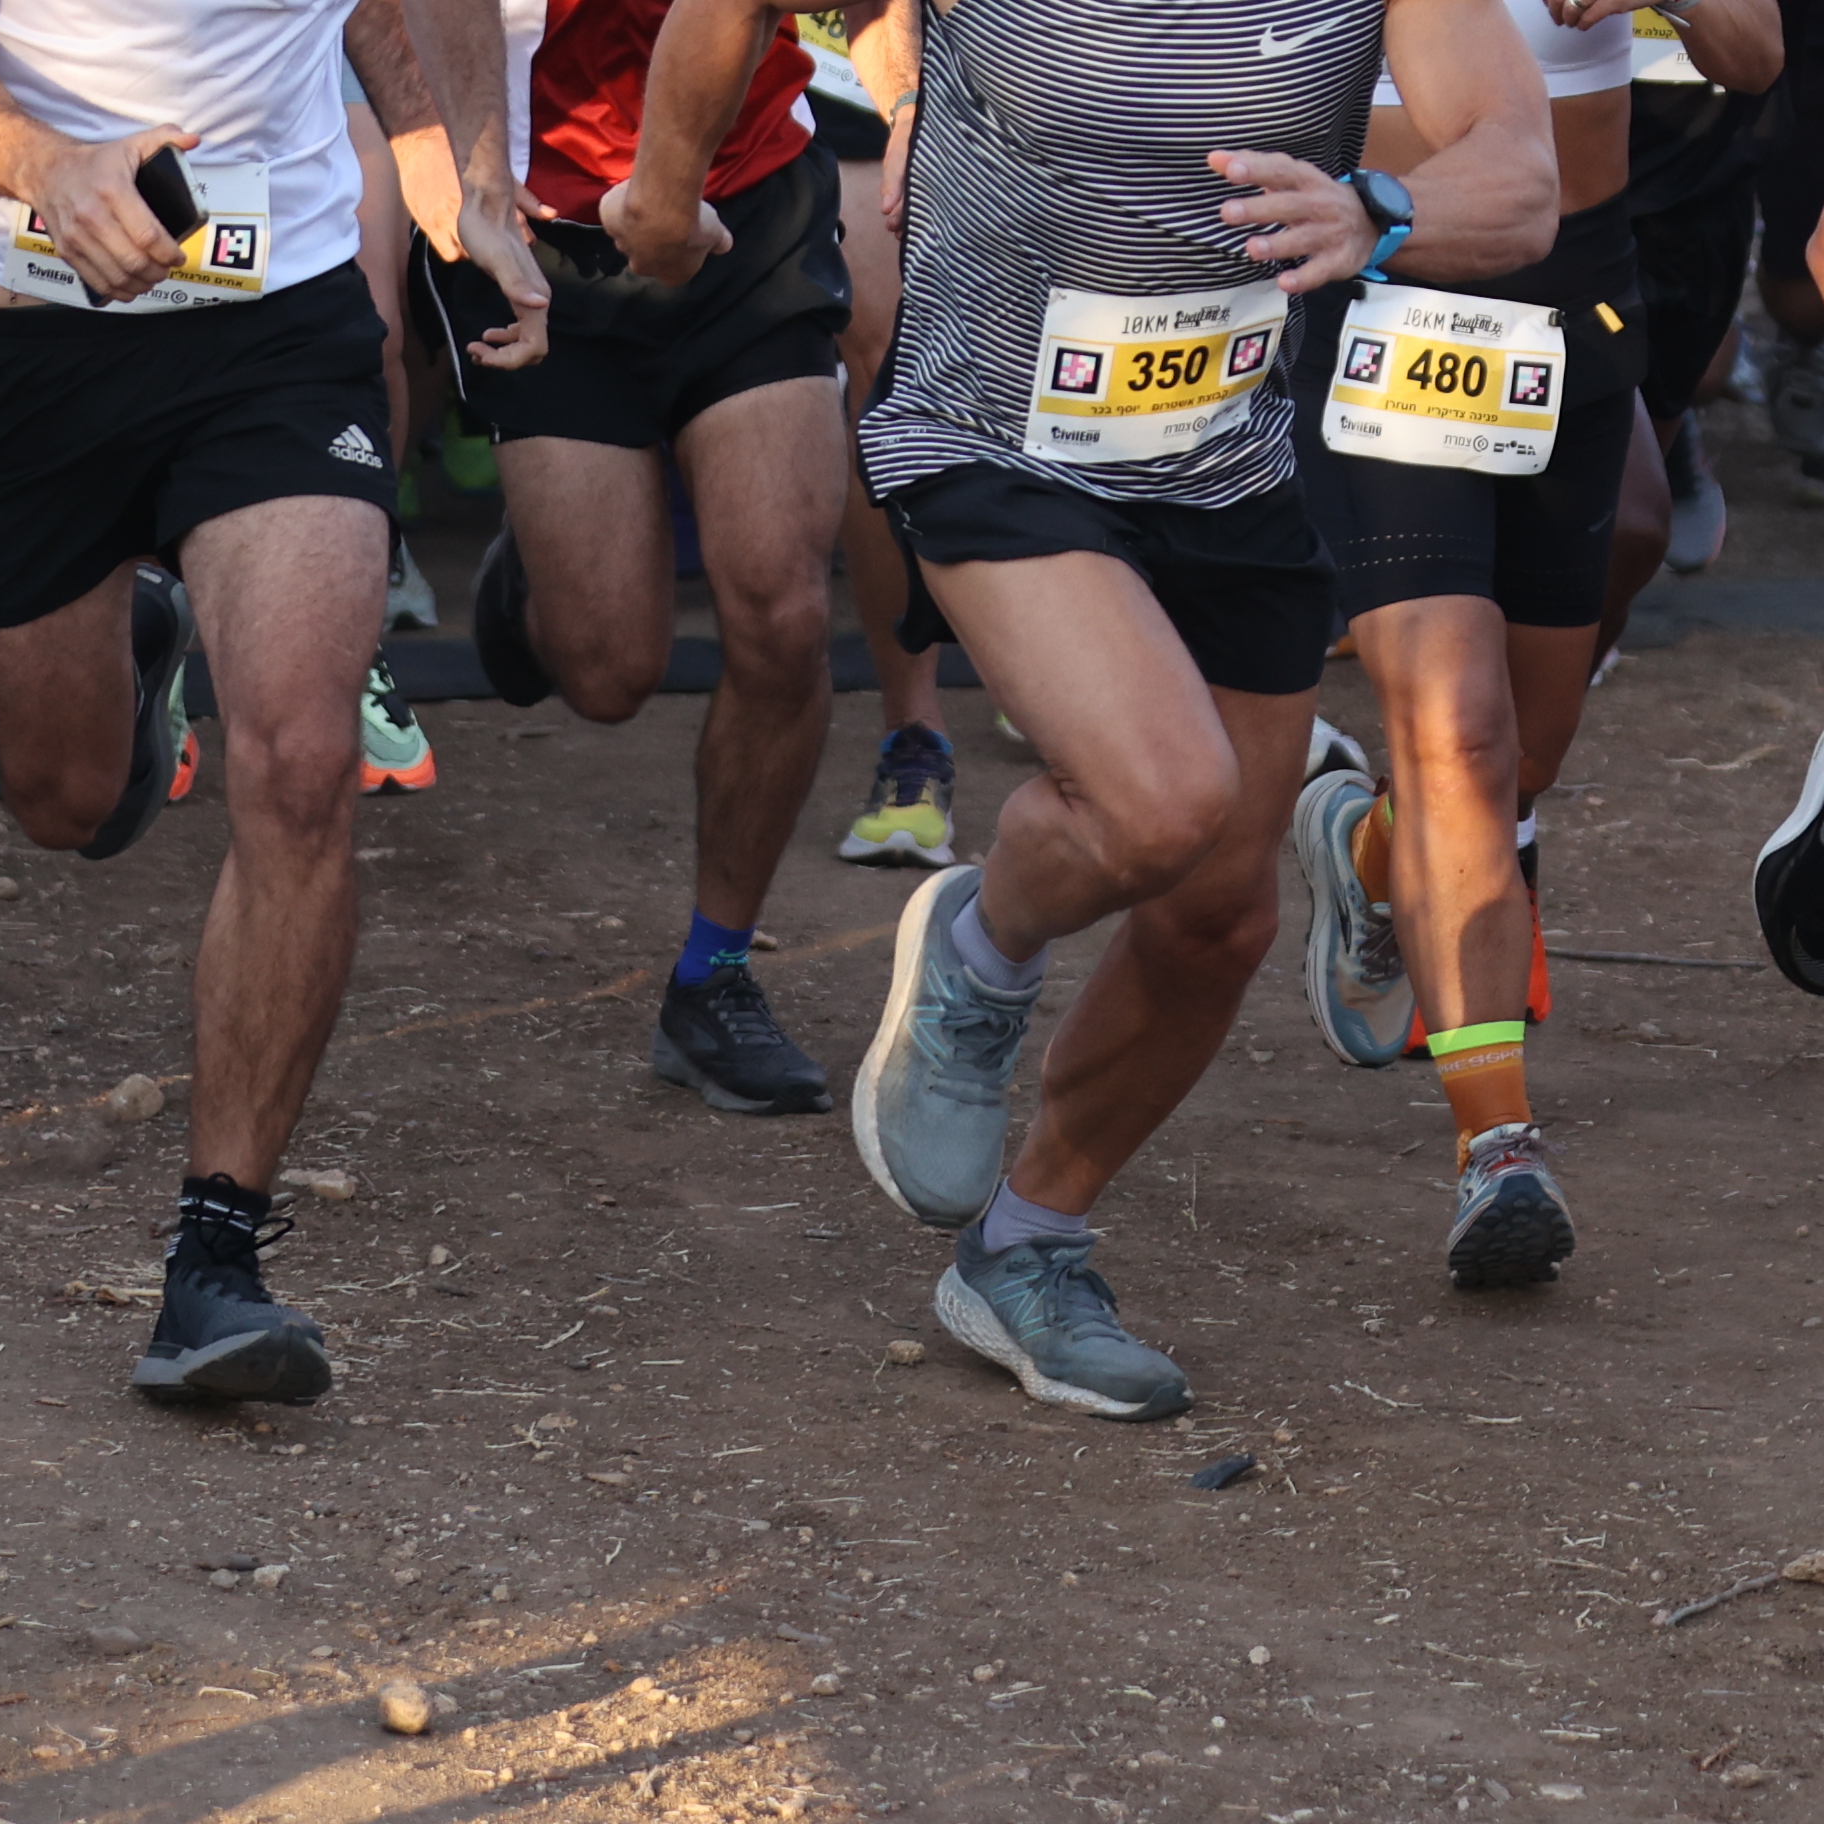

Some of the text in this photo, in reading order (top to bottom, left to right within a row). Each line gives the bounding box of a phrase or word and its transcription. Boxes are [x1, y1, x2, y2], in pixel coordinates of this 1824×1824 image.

[27, 262, 74, 284] CivilEng
[1121, 314, 1169, 335] 10KM
[1403, 307, 1446, 331] 10KM
[1127, 345, 1210, 392] 350
[1406, 347, 1488, 398] 480
[1051, 426, 1100, 443] CivilEng
[1340, 415, 1383, 437] CivilEng
[1443, 433, 1472, 447] צמרת
